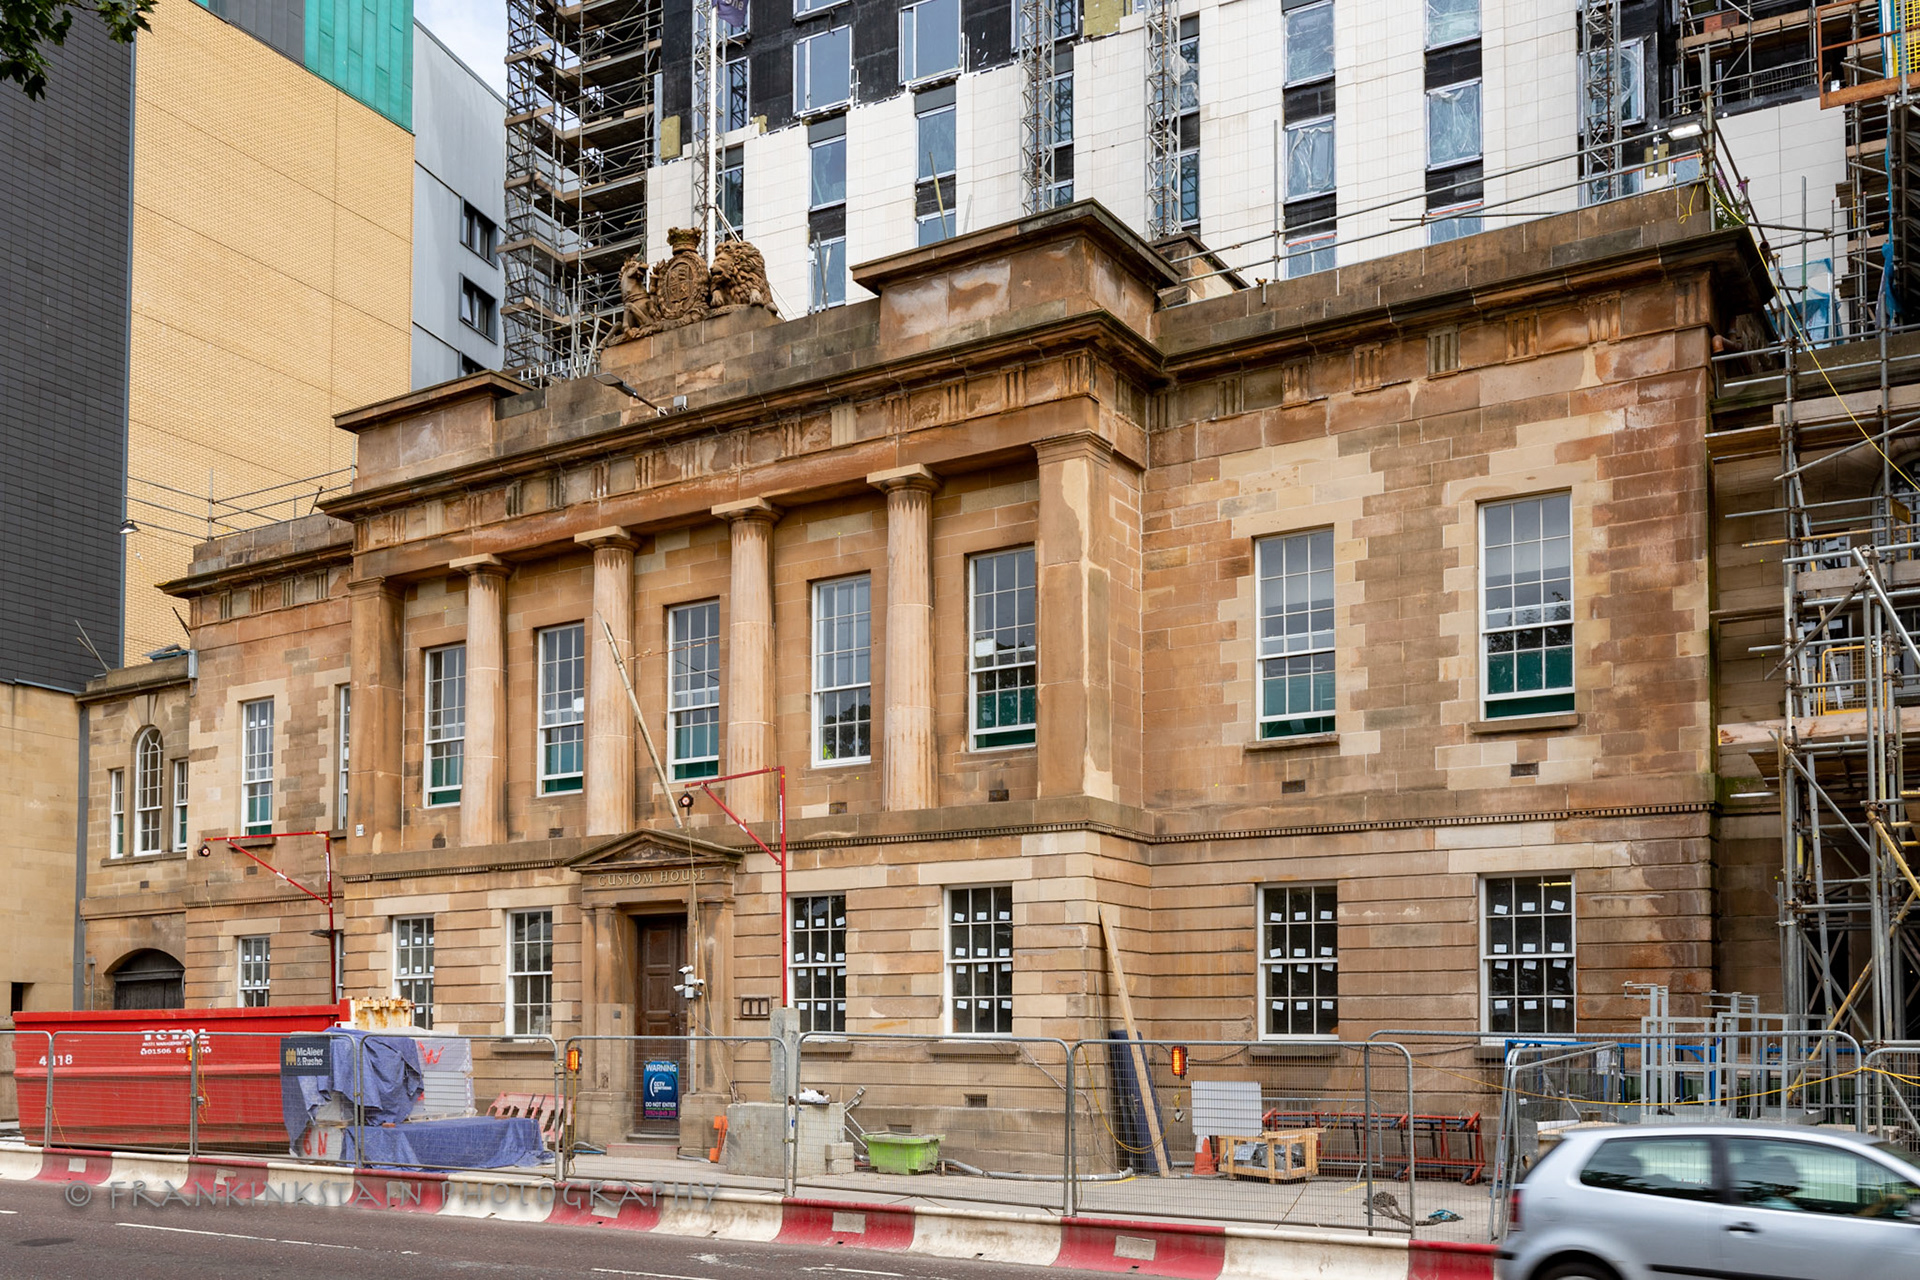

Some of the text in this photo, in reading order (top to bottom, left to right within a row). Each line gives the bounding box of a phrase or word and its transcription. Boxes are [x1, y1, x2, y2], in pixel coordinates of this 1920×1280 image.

[598, 868, 706, 886] CUSTOM HOUSE
[140, 1028, 210, 1040] TOTAL
[296, 1047, 324, 1057] McAleer
[296, 1056, 324, 1066] & Rushe
